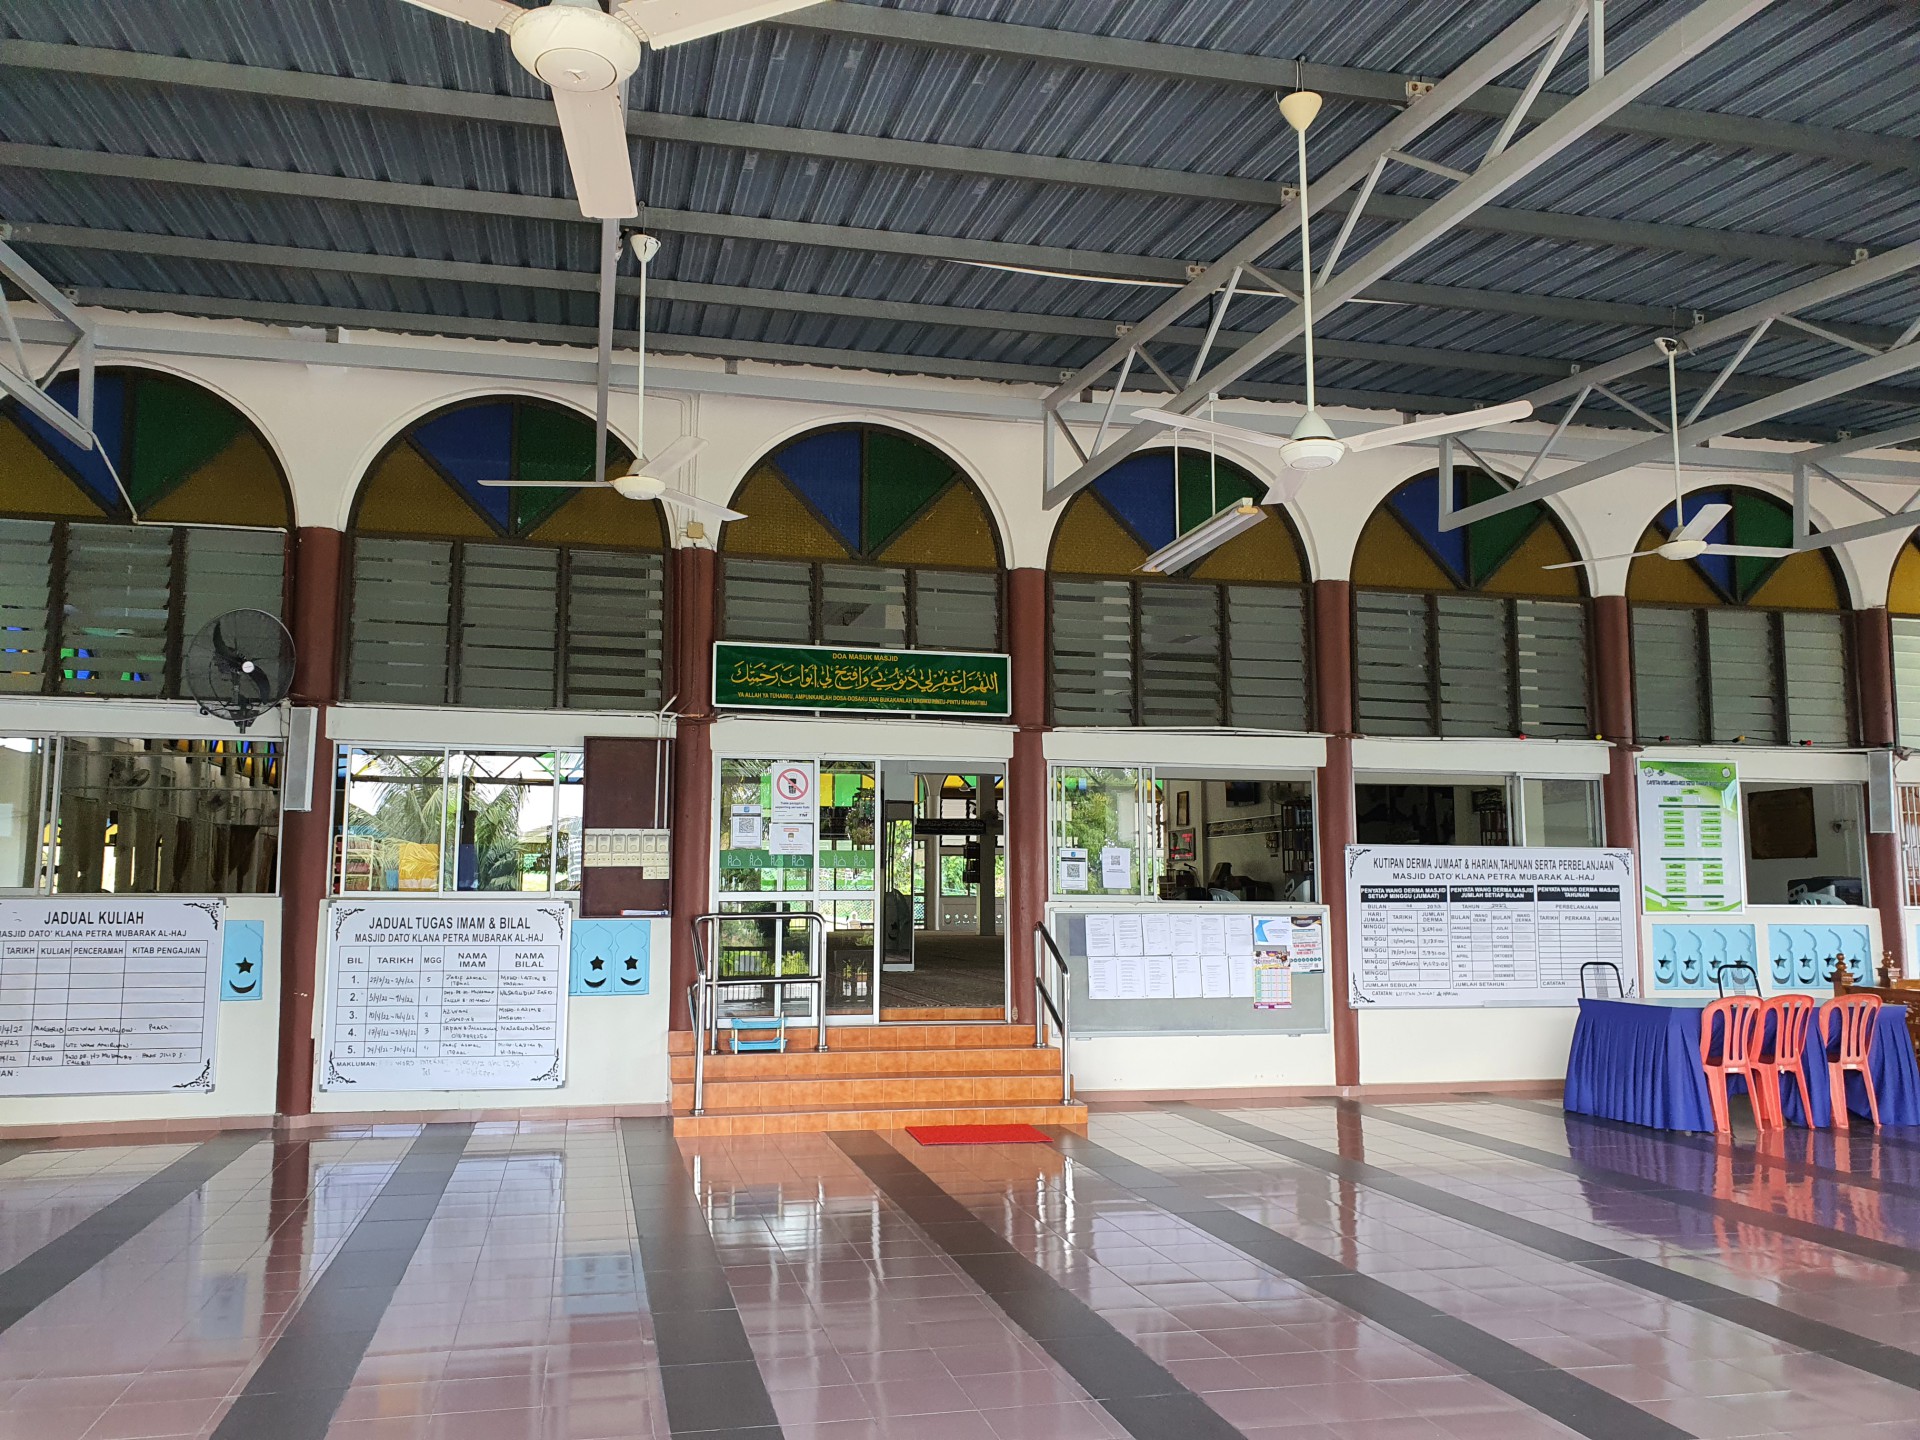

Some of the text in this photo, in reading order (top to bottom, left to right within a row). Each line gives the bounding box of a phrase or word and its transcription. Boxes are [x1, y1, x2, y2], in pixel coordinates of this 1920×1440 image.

[874, 654, 898, 662] MASJID
[1373, 858, 1404, 868] KUTIPAN
[1406, 858, 1432, 869] DERMA
[1434, 858, 1462, 869] JUMAAT
[1465, 859, 1469, 869] &
[1535, 859, 1556, 870] SERTA
[1558, 860, 1614, 871] PERBELANJAAN
[44, 911, 144, 925] JADUAL KULIAH
[369, 917, 530, 929] JADUAL TUGAS IMAM & BILAL
[29, 930, 53, 938] DATO'
[355, 934, 386, 942] MASJID
[412, 934, 440, 942] KLANA
[443, 934, 469, 942] PETRA
[472, 933, 513, 942] MUBARAK
[514, 933, 544, 942] AL-HAJ
[74, 947, 123, 955] PENCERAMAH
[351, 975, 359, 984] 1.
[350, 993, 358, 1002] 2.
[349, 1011, 357, 1020] 3.
[348, 1028, 357, 1037] 4.
[347, 1045, 356, 1054] 5.
